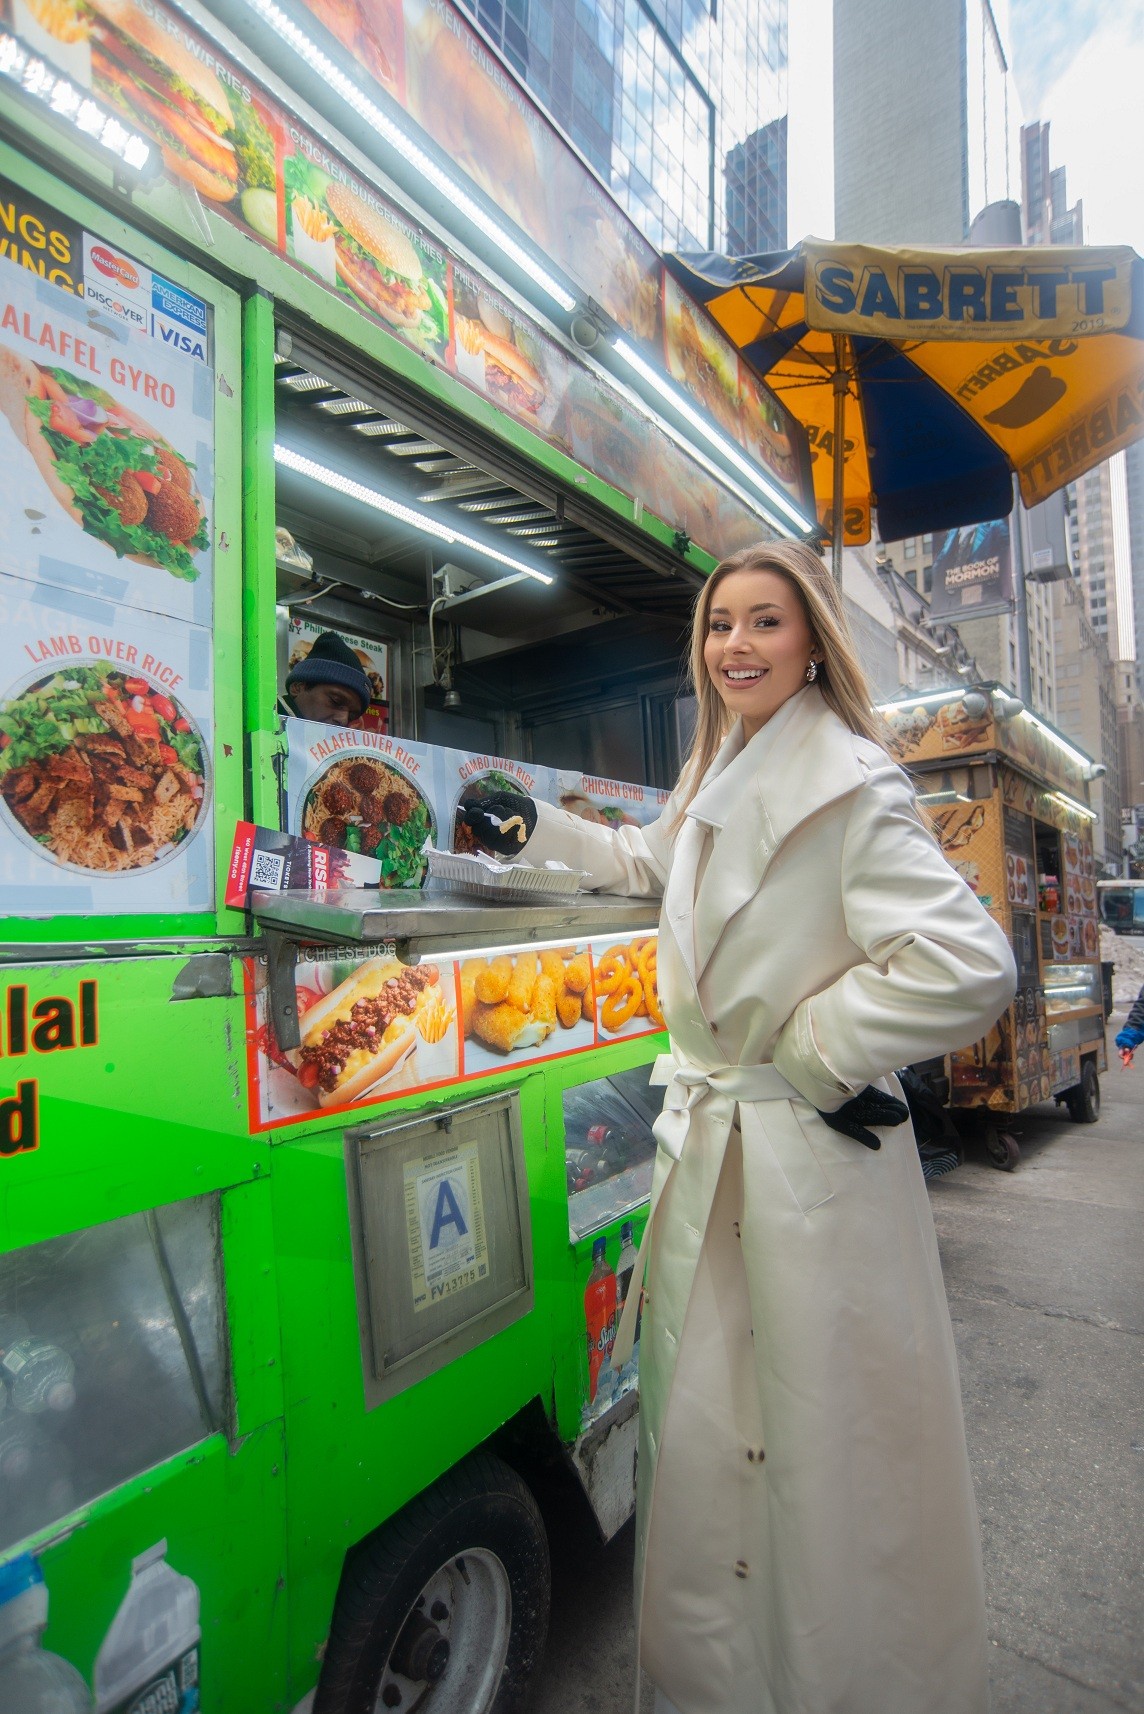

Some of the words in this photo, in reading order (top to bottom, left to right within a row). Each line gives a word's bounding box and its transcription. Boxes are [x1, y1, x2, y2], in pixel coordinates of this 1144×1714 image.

[184, 31, 252, 103] W/FRIES
[290, 127, 348, 187] CHICKEN
[351, 183, 400, 229] BURGER
[401, 222, 443, 265] W/FRIES
[0, 237, 84, 297] ING
[90, 250, 140, 284] MasterCard
[87, 286, 144, 325] DISCOVER
[151, 282, 204, 320] AMERICAN
[815, 260, 1117, 322] SABRETT
[163, 299, 207, 330] EXPRESS
[157, 321, 205, 362] VISA
[110, 357, 176, 409] GYRO
[945, 566, 961, 576] THE
[962, 560, 986, 573] BOOK
[987, 556, 999, 566] OF
[945, 563, 999, 585] MORMON
[24, 635, 83, 664] LAMB
[88, 635, 138, 664] OVER
[140, 653, 184, 691] RICE
[360, 640, 383, 653] Steak
[309, 731, 360, 762] FALAFEL
[361, 732, 393, 754] OVER
[395, 746, 421, 776] RICE
[458, 755, 490, 780] COMBO
[492, 756, 514, 773] OVER
[515, 766, 536, 791] RICE
[581, 775, 621, 797] CHICKEN
[622, 782, 644, 802] GYRO
[231, 846, 241, 879] riseny.co
[304, 945, 364, 963] CHEESE
[367, 942, 397, 958] DOG
[0, 979, 98, 1057] lal
[429, 1180, 469, 1250] A
